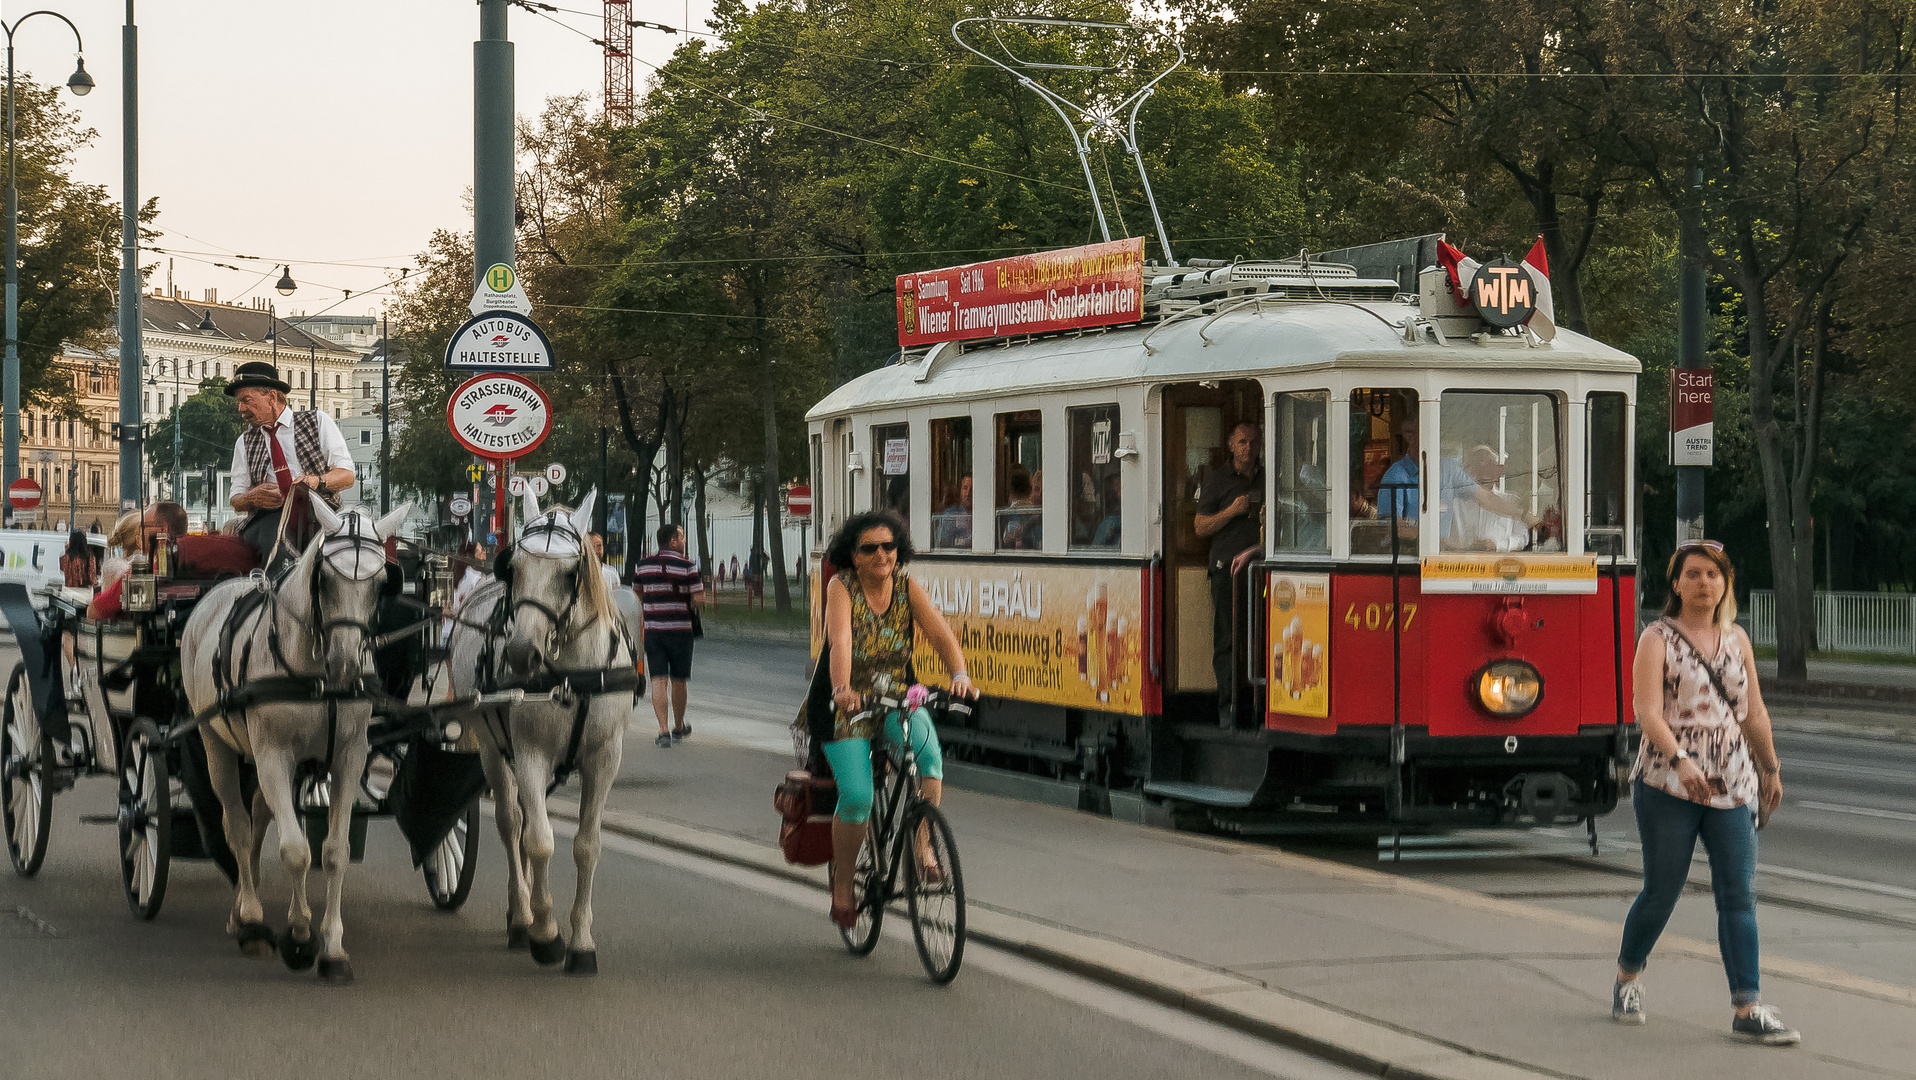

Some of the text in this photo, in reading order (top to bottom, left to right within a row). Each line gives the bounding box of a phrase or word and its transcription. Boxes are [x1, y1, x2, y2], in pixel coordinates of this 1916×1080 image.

[1081, 247, 1135, 278] www.tram.at
[494, 270, 507, 287] H
[918, 276, 948, 302] Sammlung
[960, 268, 984, 294] Seit 1966
[1477, 267, 1531, 315] WTM
[472, 320, 531, 342] AUTOBUS
[918, 305, 952, 335] Wiener
[460, 351, 541, 364] HALTESTELLE
[1679, 373, 1713, 387] Start
[460, 383, 541, 412] STRASSENBAHN
[511, 480, 524, 491] 71
[536, 481, 541, 491] 1
[551, 469, 561, 479] D
[1438, 562, 1486, 574] Sonderzug
[979, 568, 1042, 621] BRÄU
[1345, 602, 1418, 632] 4077
[961, 620, 1063, 665] Am Rennweg 8
[915, 648, 935, 675] wird
[986, 655, 1009, 682] Bier
